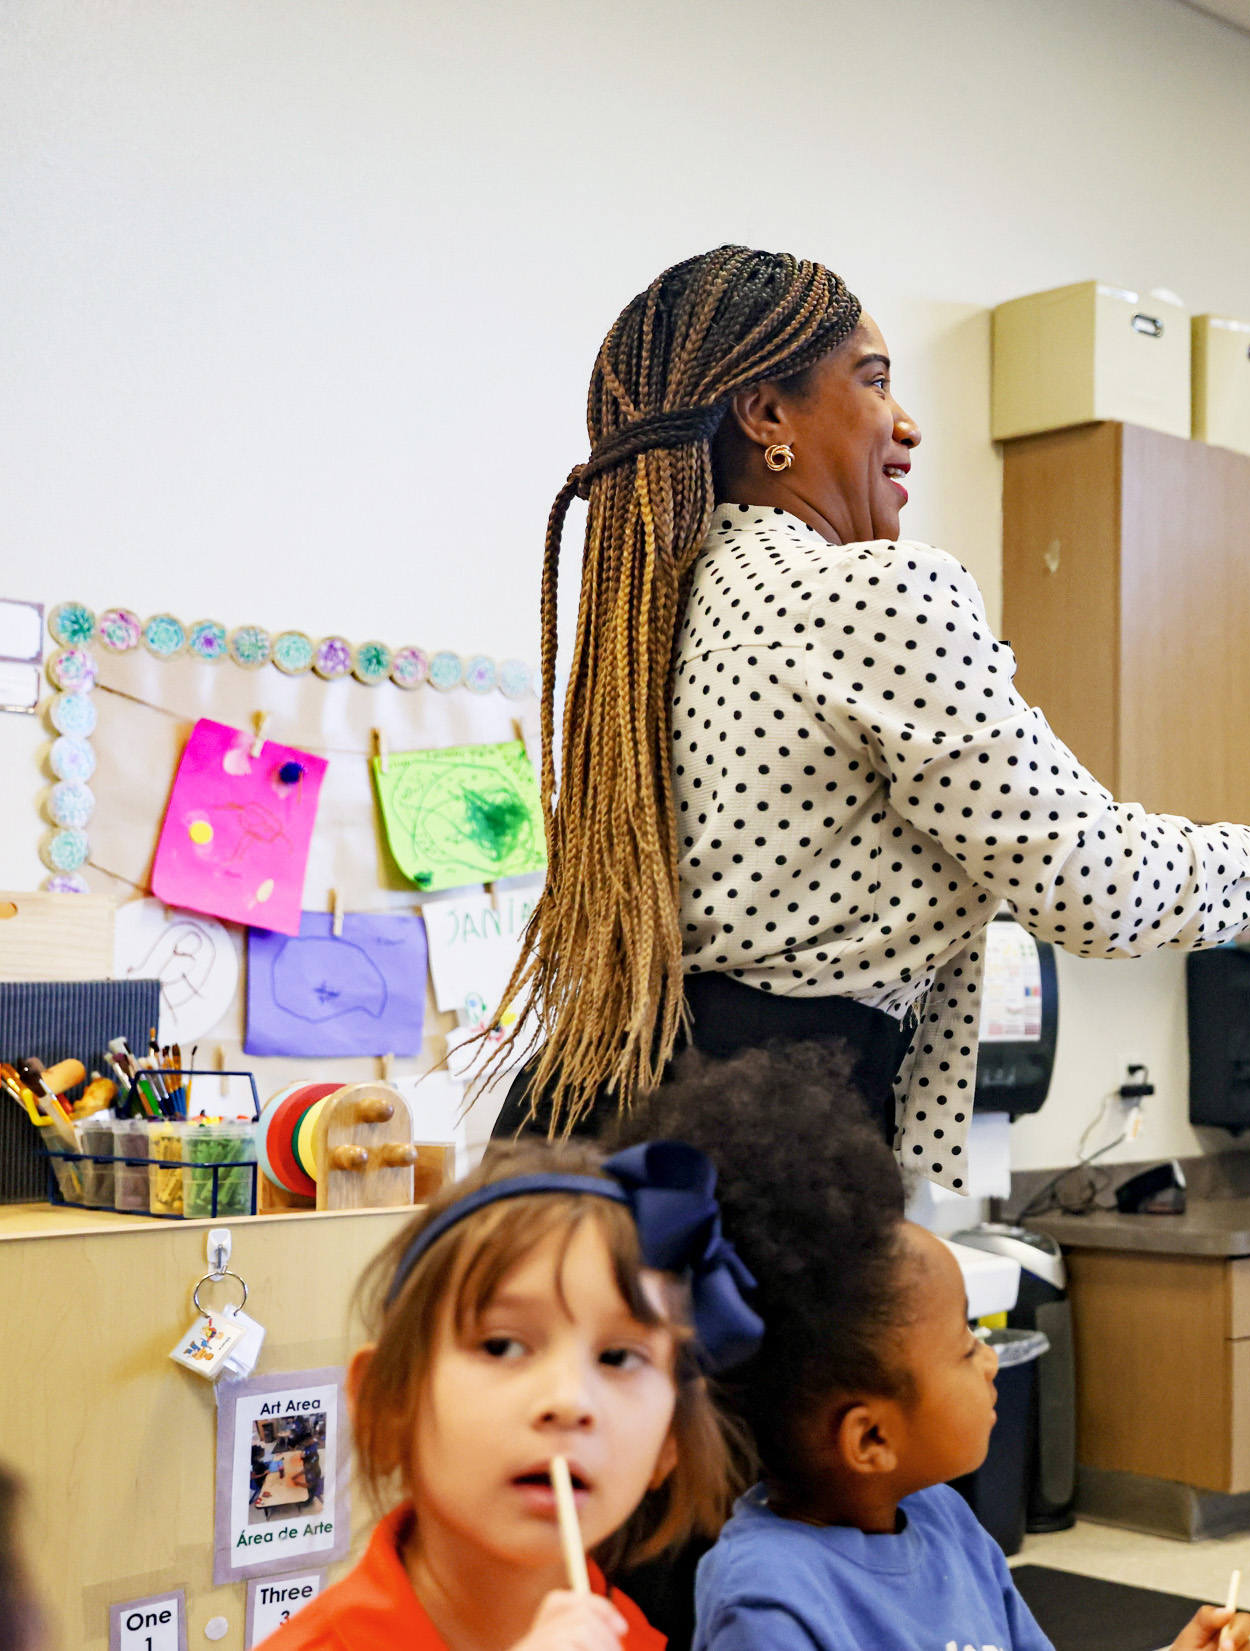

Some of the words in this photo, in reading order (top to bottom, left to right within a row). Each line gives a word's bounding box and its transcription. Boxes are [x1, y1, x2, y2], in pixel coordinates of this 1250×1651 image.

[260, 1401, 281, 1416] Art
[285, 1399, 321, 1413] Area
[236, 1529, 274, 1548] Área
[278, 1526, 298, 1541] de
[303, 1521, 333, 1538] Arte
[260, 1585, 313, 1605] Three
[126, 1610, 172, 1631] One
